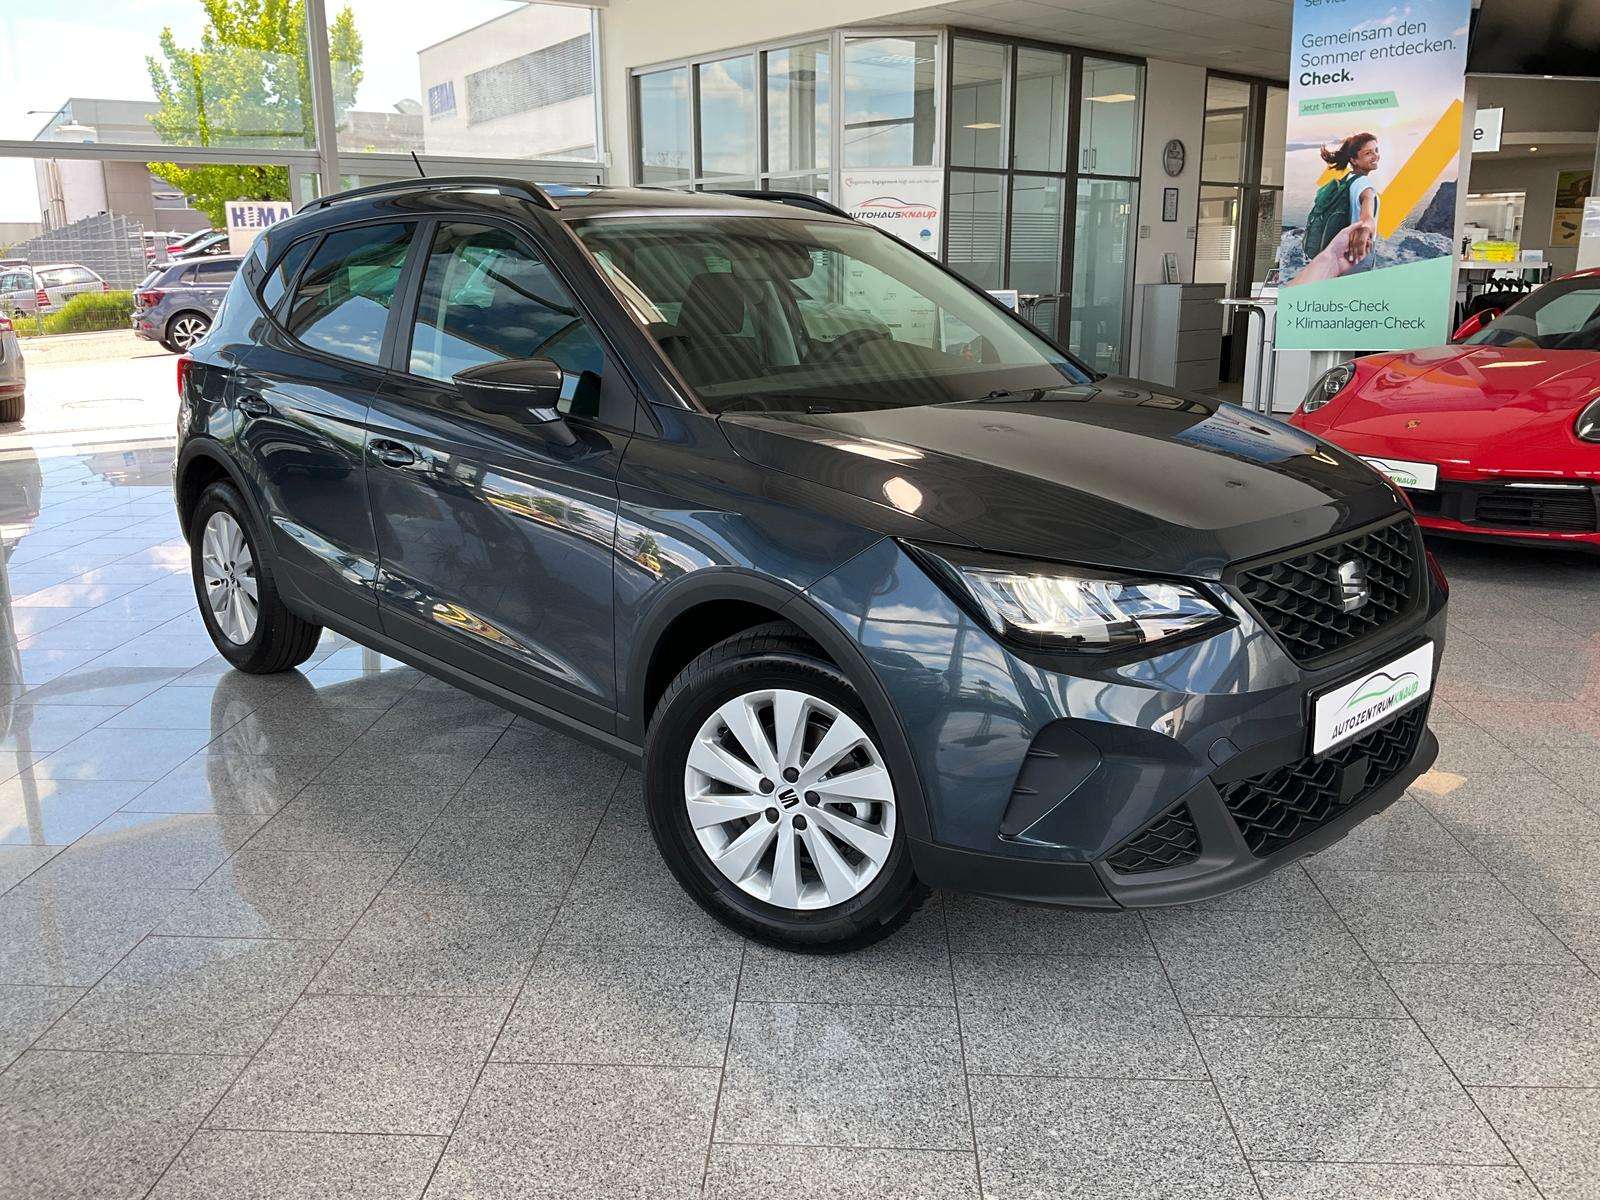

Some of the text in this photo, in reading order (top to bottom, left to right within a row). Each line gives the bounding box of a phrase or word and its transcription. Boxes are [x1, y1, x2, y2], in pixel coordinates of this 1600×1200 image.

[1301, 21, 1427, 48] Gemeinsam den
[1300, 38, 1457, 68] Sommer entdecken.
[1299, 68, 1355, 86] Check.
[1302, 96, 1389, 113] Jetzt Termin vereinbaren
[231, 206, 290, 228] HIMA
[1296, 300, 1390, 313] Urlaubs-Check
[1295, 316, 1426, 332] Klimaanlagen-Check
